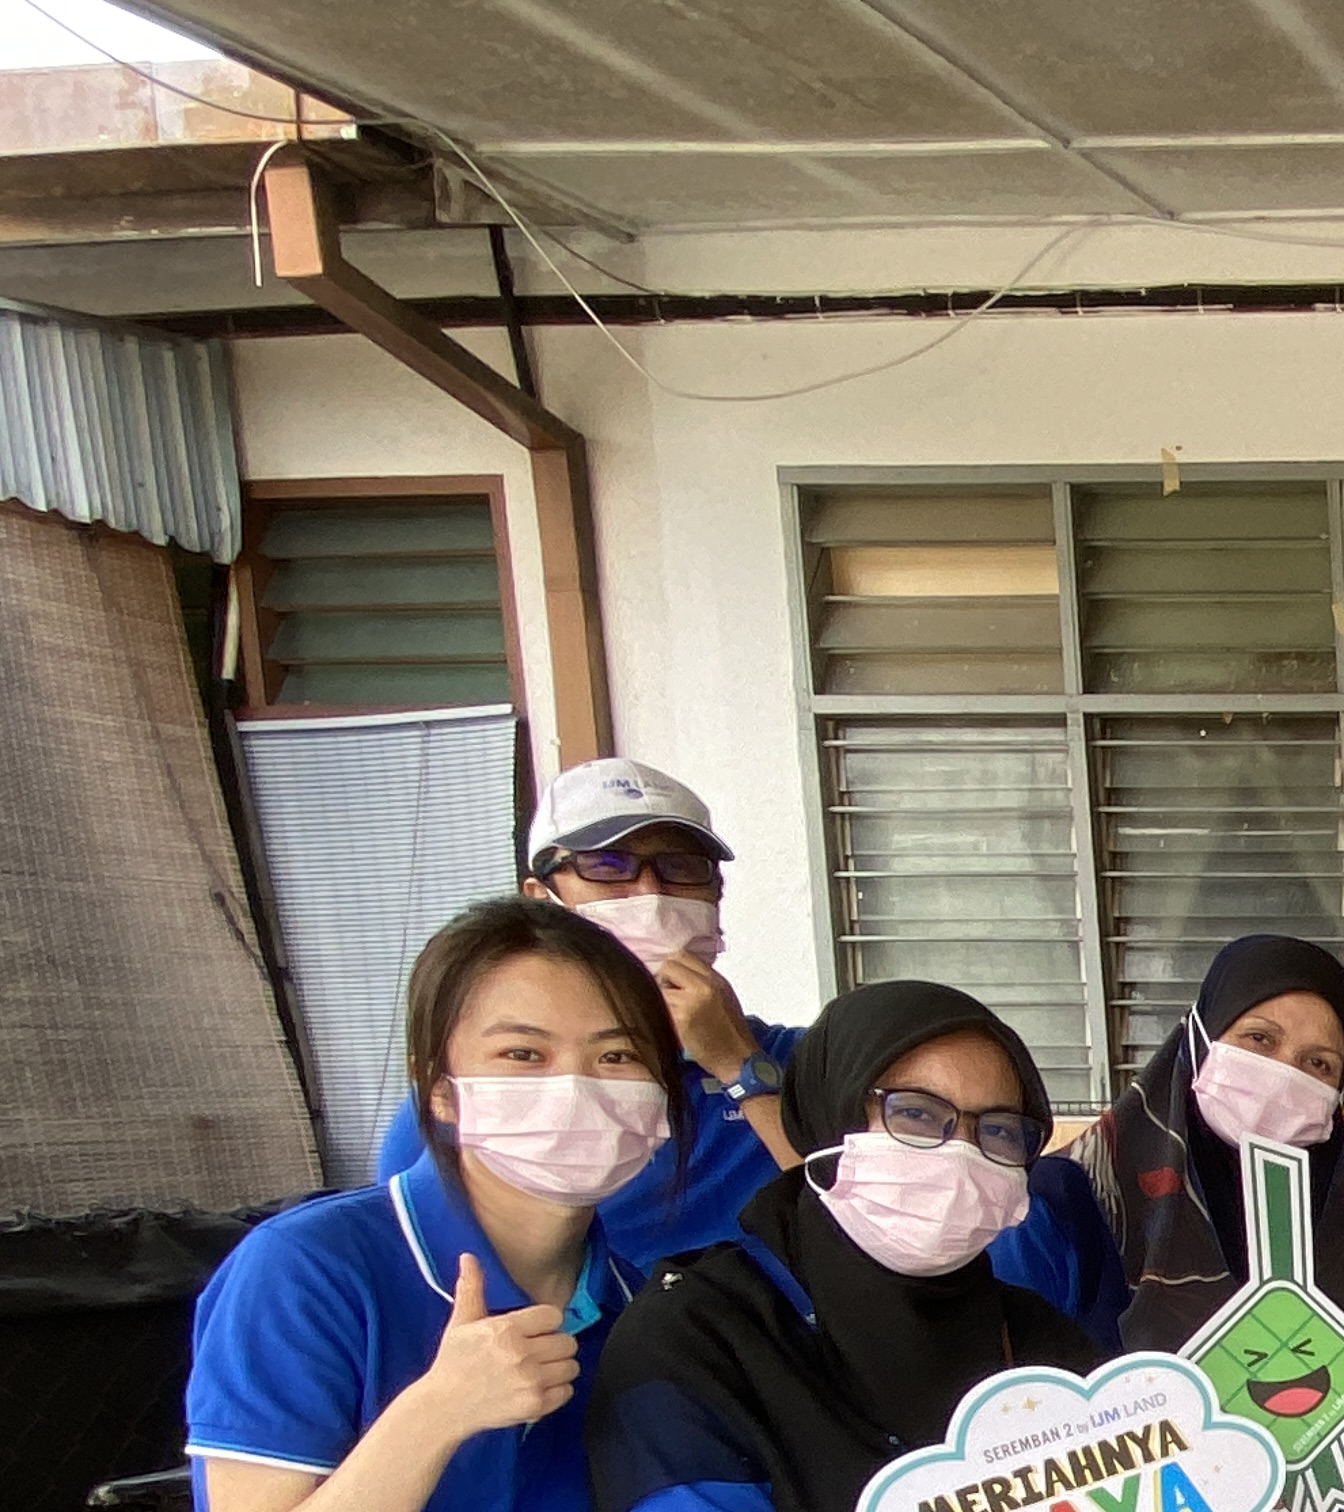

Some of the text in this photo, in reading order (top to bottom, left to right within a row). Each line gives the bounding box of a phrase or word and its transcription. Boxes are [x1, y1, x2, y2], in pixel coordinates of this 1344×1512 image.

[984, 1427, 1061, 1464] SEREMBAN
[1063, 1423, 1074, 1438] 2
[1090, 1409, 1121, 1428] IJM
[1122, 1392, 1168, 1418] LAND
